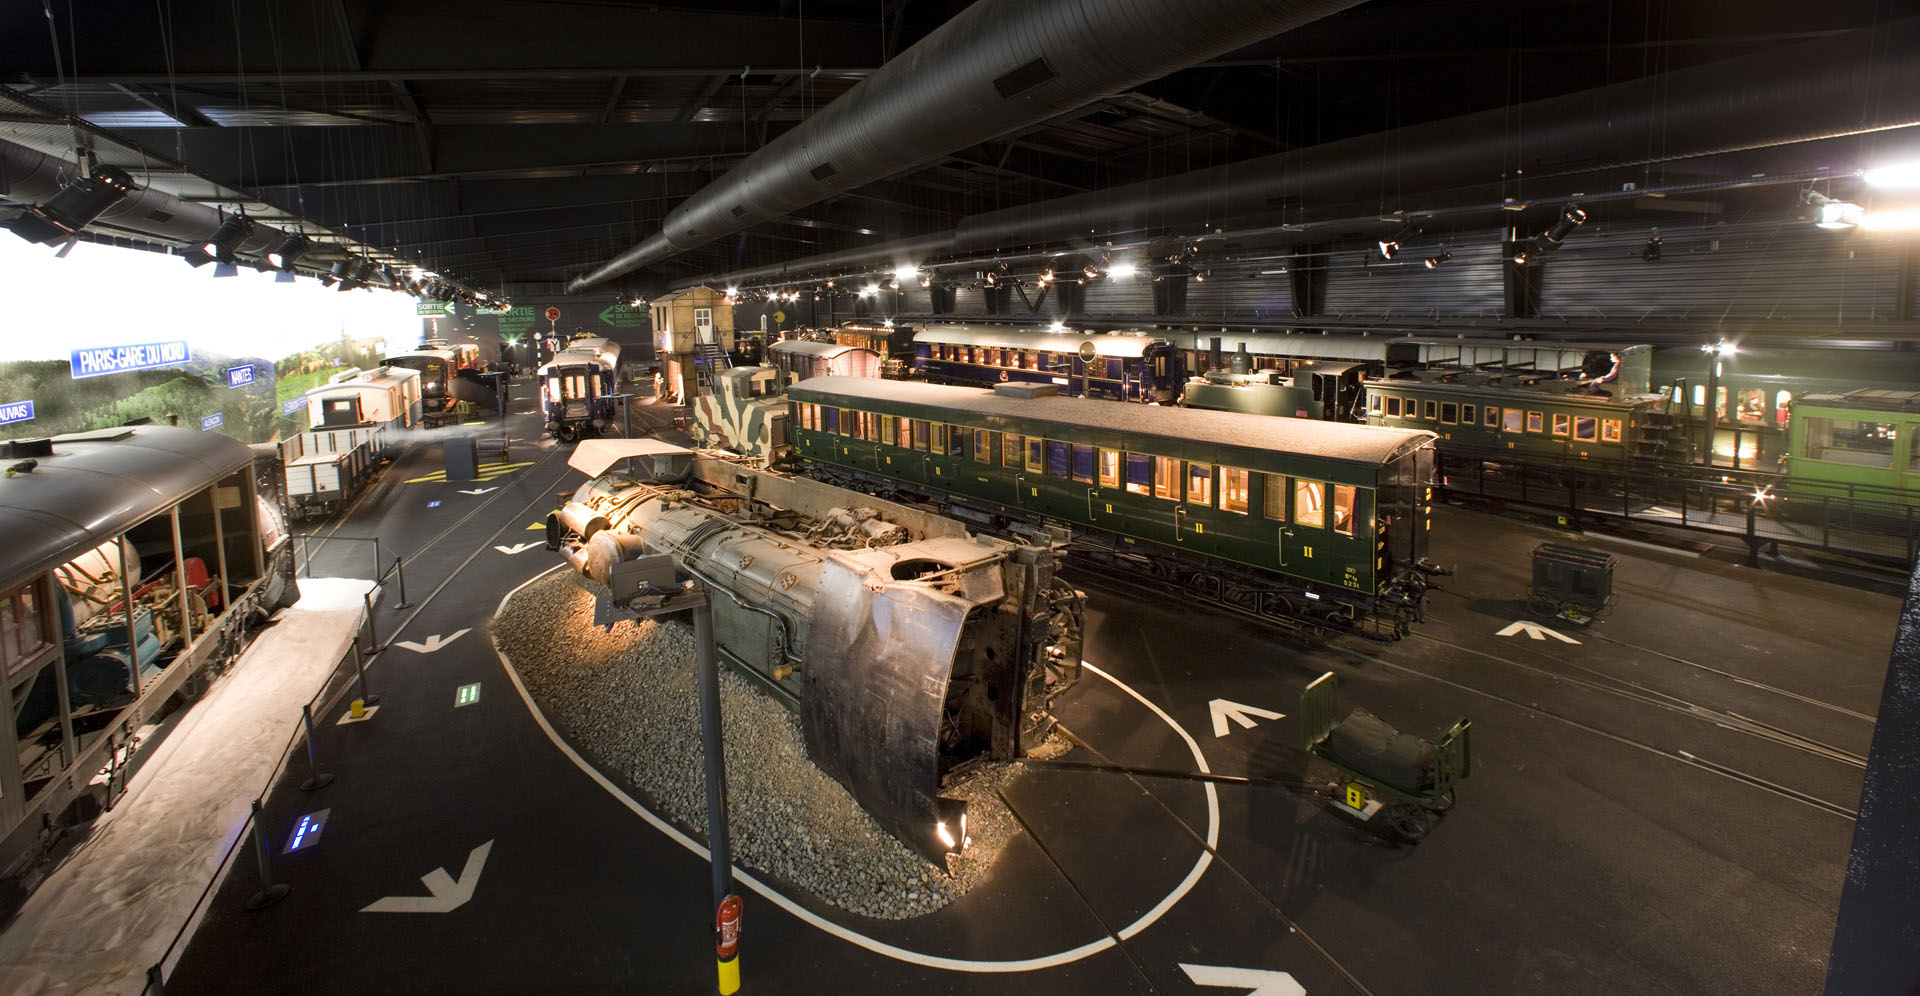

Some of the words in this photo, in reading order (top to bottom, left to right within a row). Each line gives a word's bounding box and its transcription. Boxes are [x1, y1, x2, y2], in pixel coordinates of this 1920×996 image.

[498, 306, 535, 317] ORTIE
[79, 346, 146, 373] PARIS-GARE
[146, 344, 161, 365] DU
[161, 342, 185, 362] NORD
[230, 368, 253, 385] NANTES
[1031, 487, 1038, 497] II
[1105, 503, 1113, 514] II
[1195, 522, 1204, 534] II
[1303, 545, 1313, 559] II
